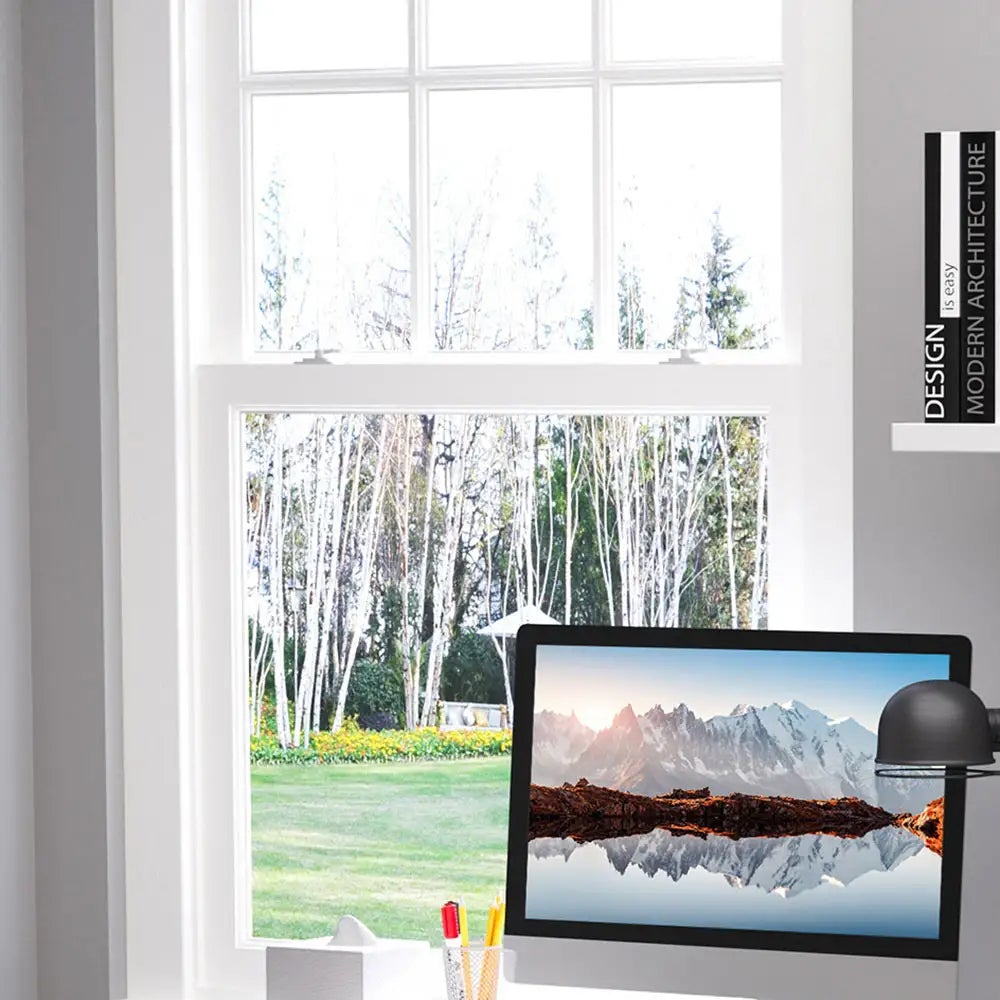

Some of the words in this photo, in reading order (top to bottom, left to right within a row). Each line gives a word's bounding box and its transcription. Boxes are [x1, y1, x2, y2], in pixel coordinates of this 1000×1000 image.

[967, 142, 986, 308] ARCHITECTURE
[942, 300, 954, 311] is
[944, 262, 957, 297] easy
[925, 323, 945, 419] DESIGN
[967, 317, 985, 415] MODERN
